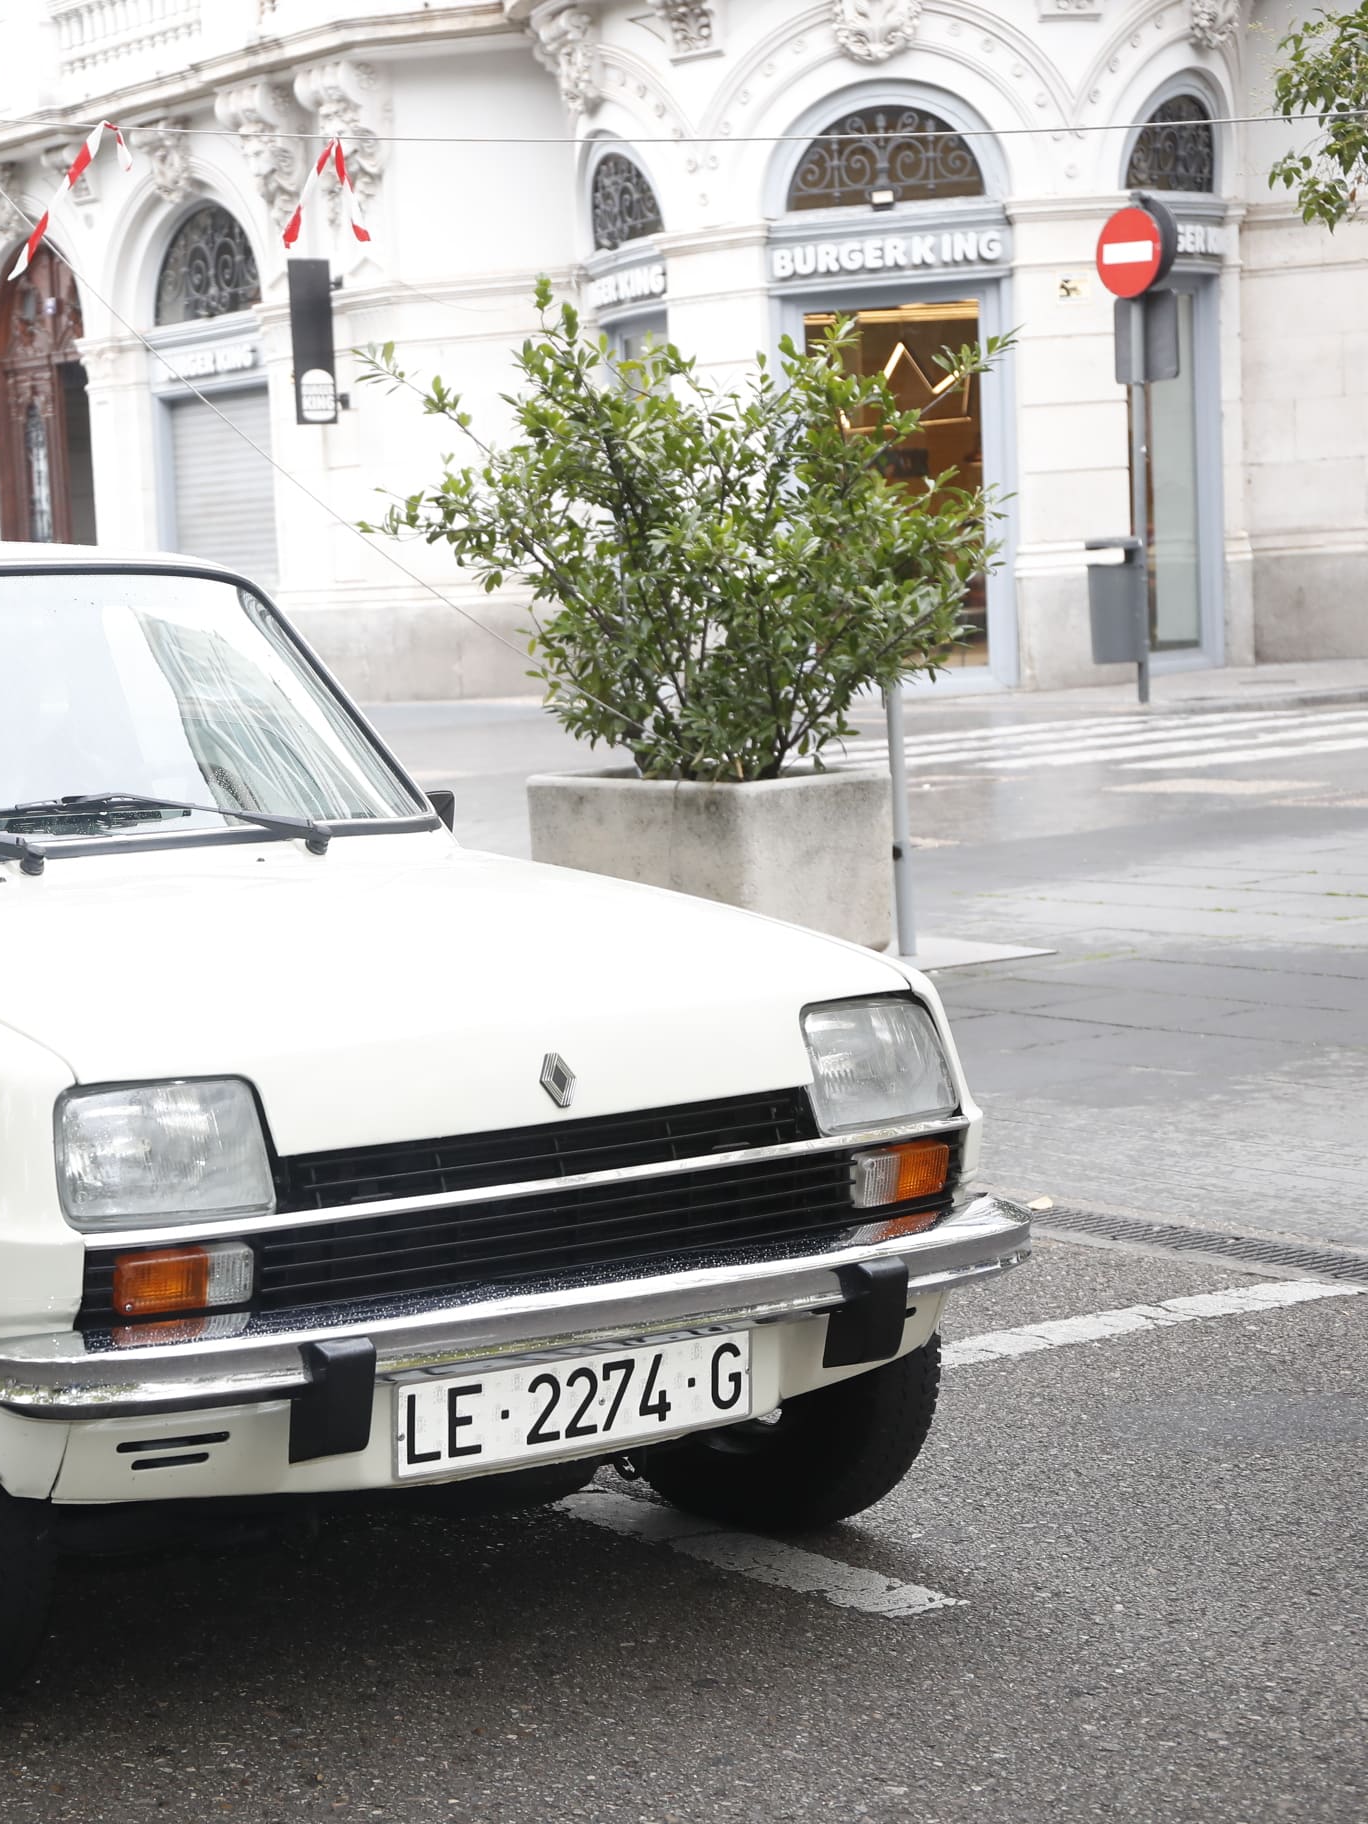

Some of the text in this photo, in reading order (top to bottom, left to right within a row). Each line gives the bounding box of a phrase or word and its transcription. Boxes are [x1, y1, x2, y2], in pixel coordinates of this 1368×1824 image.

[772, 229, 1003, 279] BURGER KING
[617, 263, 665, 300] KING
